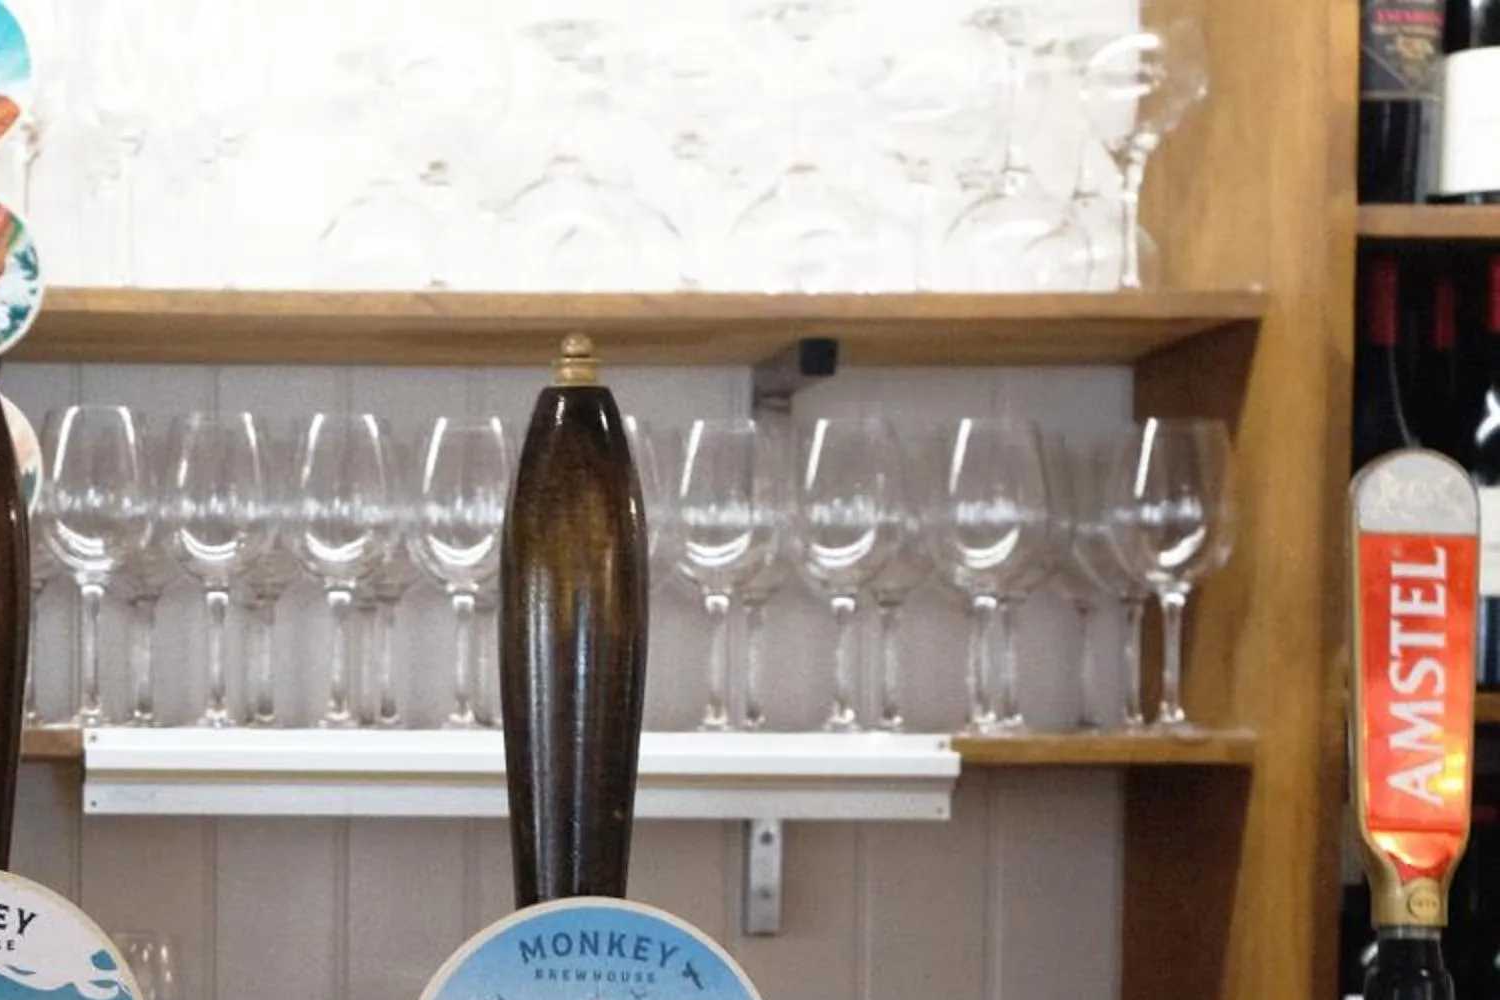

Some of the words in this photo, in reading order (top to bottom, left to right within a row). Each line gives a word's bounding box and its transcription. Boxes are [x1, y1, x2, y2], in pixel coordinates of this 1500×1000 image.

[1388, 547, 1447, 805] AMSTEL
[518, 931, 682, 969] MONKEY
[535, 968, 656, 984] BREWHOUSE
